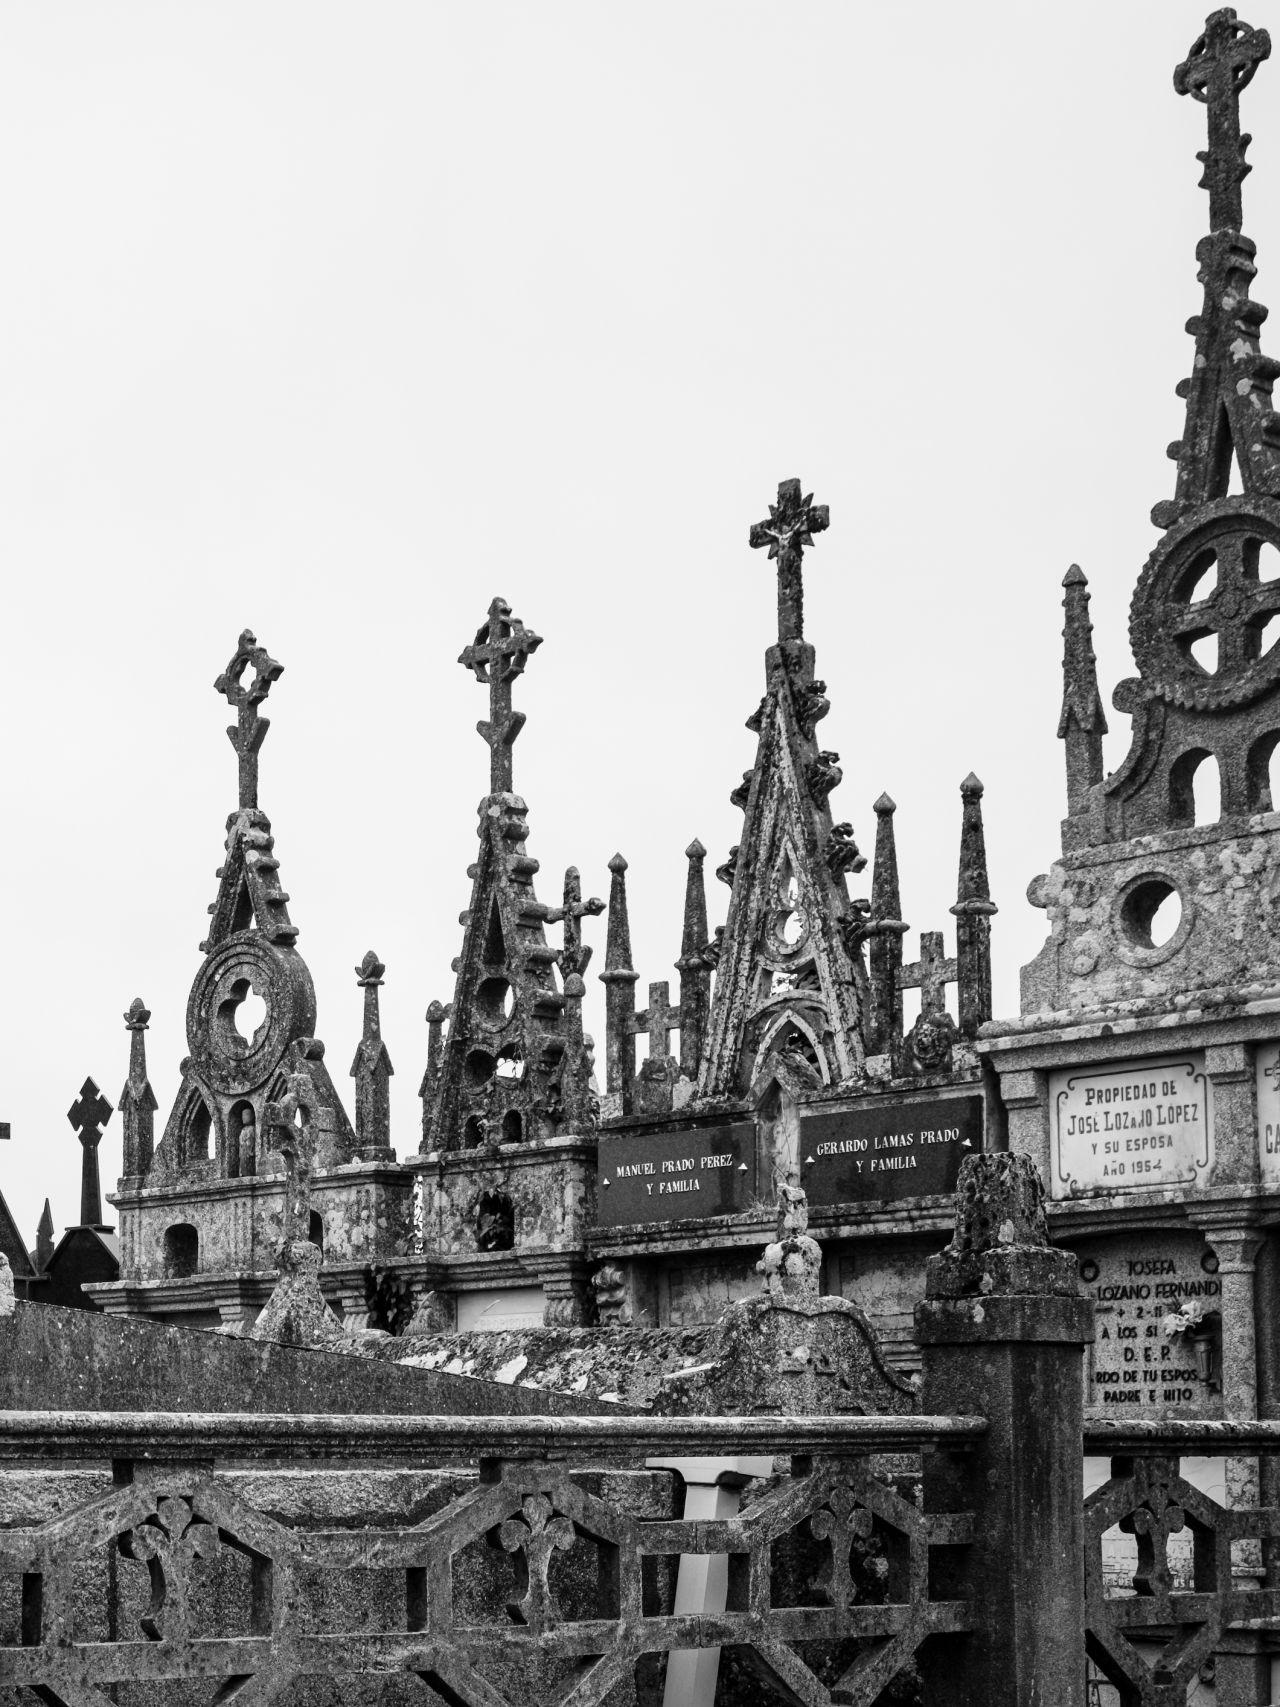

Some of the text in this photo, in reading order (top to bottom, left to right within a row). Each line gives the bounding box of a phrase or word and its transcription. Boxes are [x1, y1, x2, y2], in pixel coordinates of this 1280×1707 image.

[1085, 1080, 1177, 1105] PROPIEDAD DE
[817, 1127, 960, 1156] GERARDO LAMAS PRADO
[1092, 1135, 1173, 1155] Y SU ESPOSA
[617, 1154, 733, 1178] MANUEL PRADO PEREZ
[856, 1155, 917, 1173] Y FAMILIA
[647, 1179, 700, 1195] Y FAMILIA
[1127, 1260, 1176, 1276] JOSEFA
[1098, 1285, 1151, 1301] LOZANO
[1102, 1327, 1110, 1340] A
[1118, 1325, 1137, 1339] LOS
[1123, 1371, 1137, 1383] DE
[1143, 1370, 1157, 1382] TU
[1104, 1388, 1193, 1404] PADRE E HIJO
